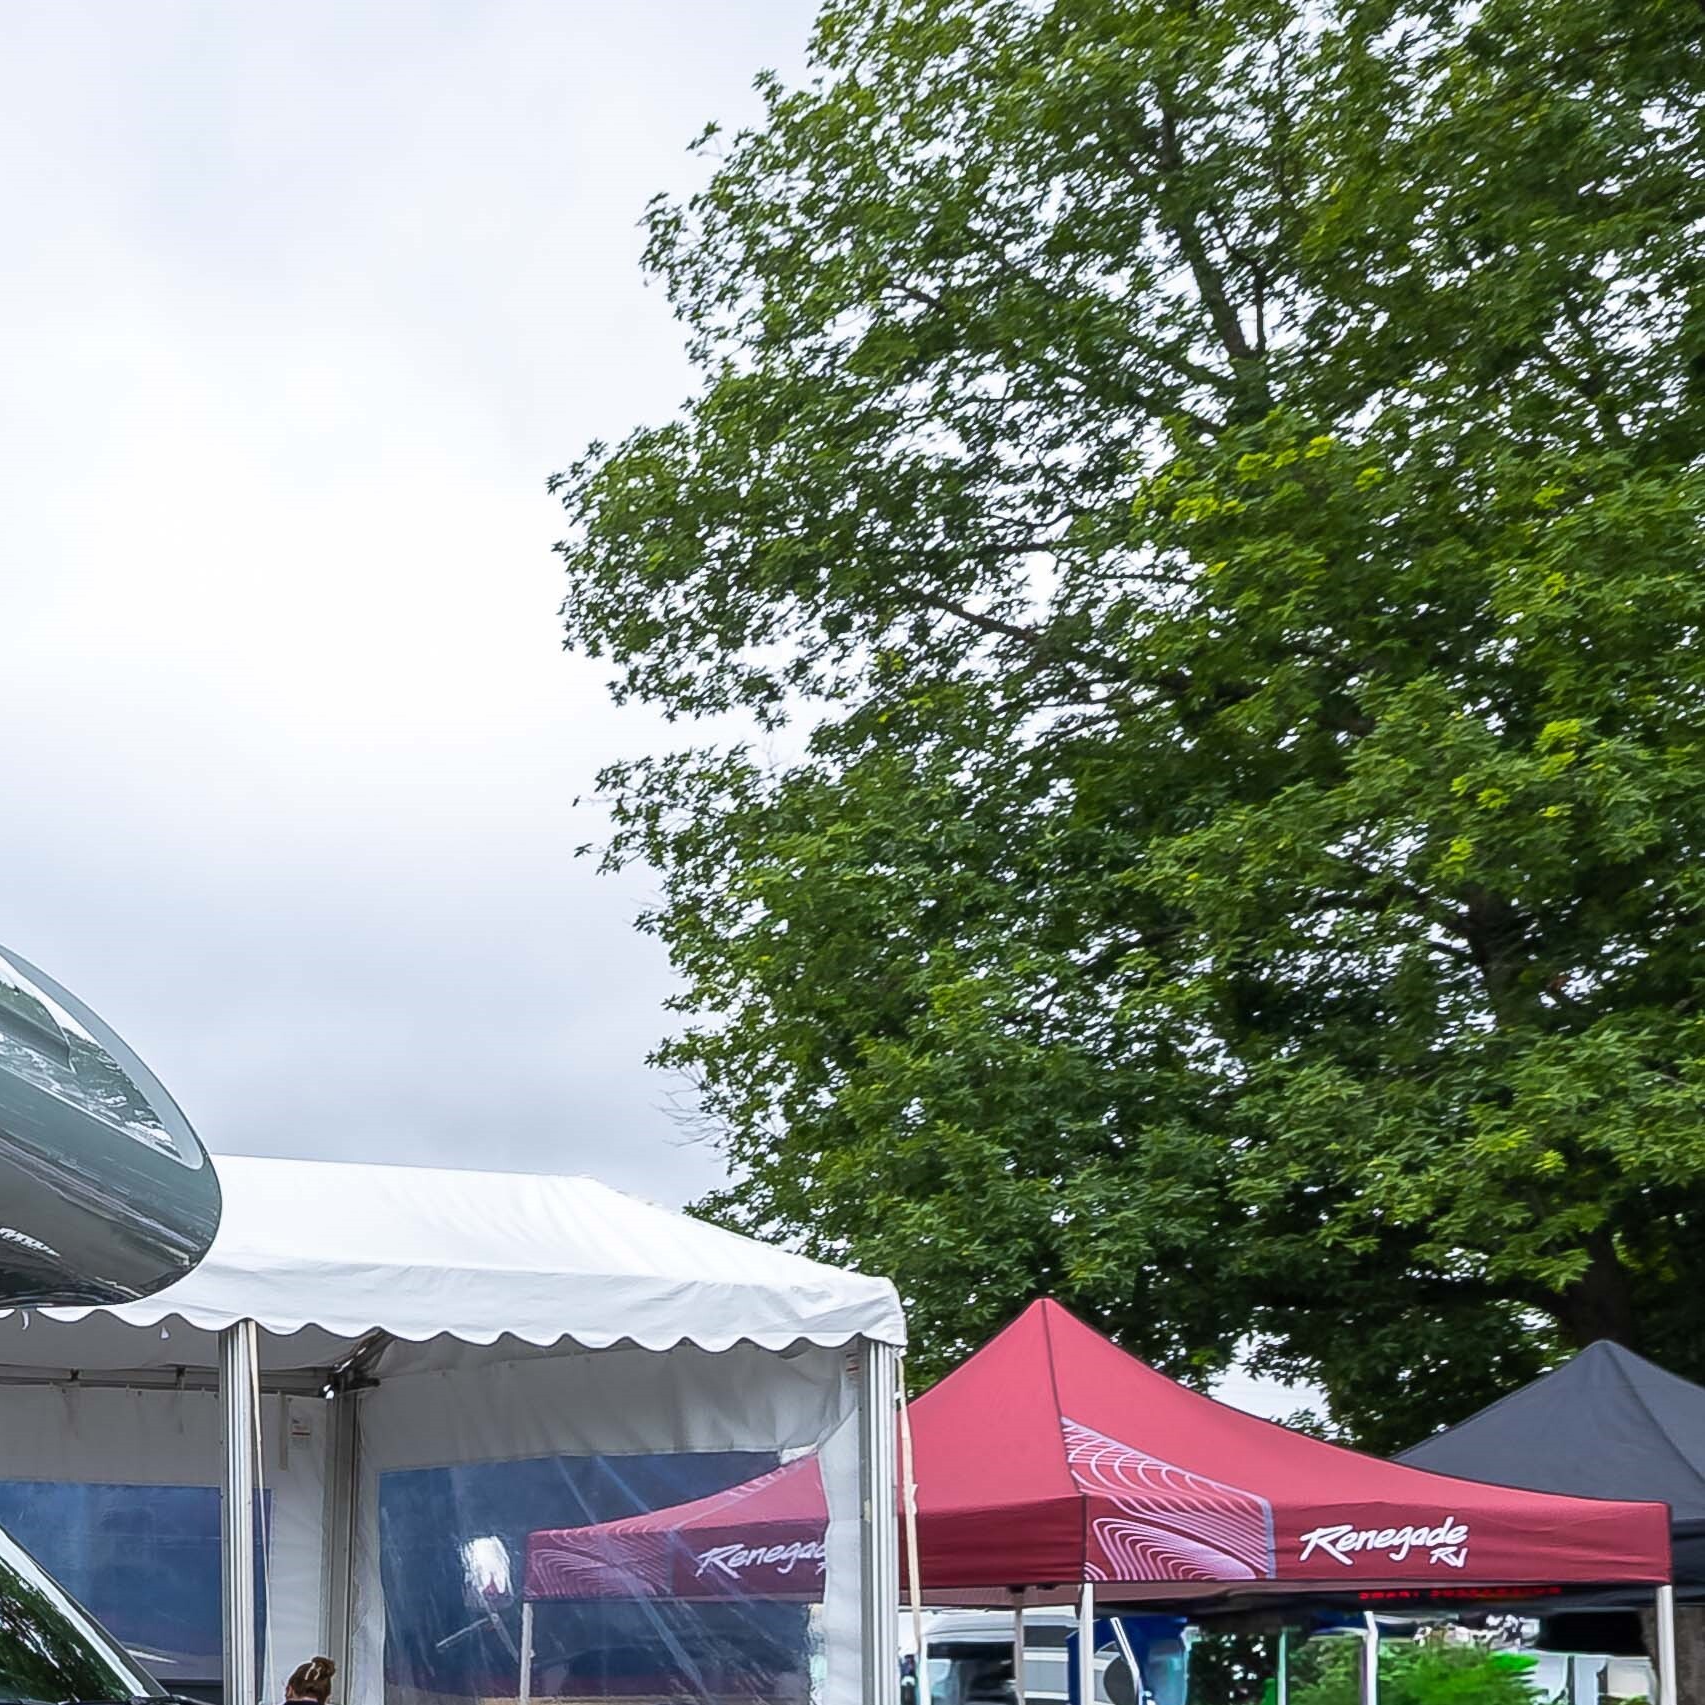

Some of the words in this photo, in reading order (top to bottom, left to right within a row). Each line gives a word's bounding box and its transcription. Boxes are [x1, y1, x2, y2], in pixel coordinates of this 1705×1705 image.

[694, 1541, 827, 1579] Renega
[1299, 1516, 1469, 1566] Renegade
[1429, 1547, 1468, 1568] RV
